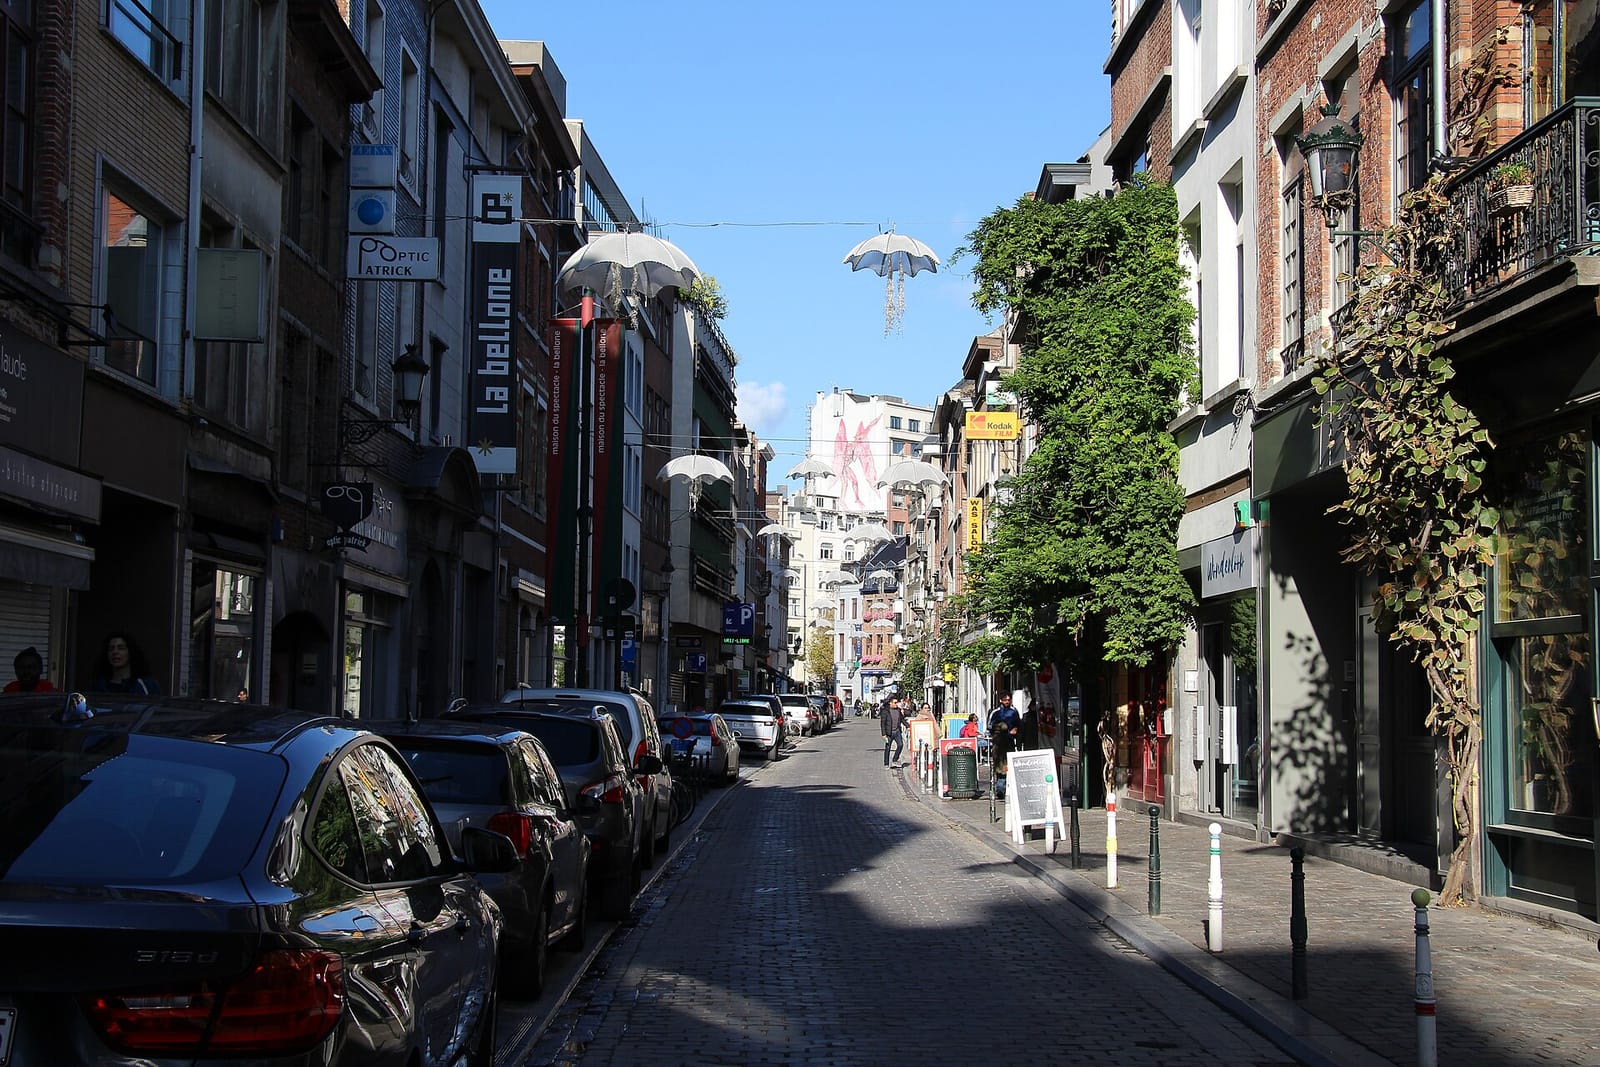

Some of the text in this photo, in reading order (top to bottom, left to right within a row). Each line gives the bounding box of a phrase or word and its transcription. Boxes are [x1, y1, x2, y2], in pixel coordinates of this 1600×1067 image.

[477, 268, 512, 414] la bellone
[553, 330, 561, 360] bellone
[599, 328, 607, 358] bellone
[553, 360, 560, 369] la
[553, 375, 561, 412] spectacle
[598, 373, 606, 411] spectacle
[552, 413, 560, 425] du
[598, 412, 606, 424] du
[987, 422, 1013, 430] Kodak
[598, 425, 606, 454] maison
[970, 500, 979, 551] WAS SALON
[741, 608, 752, 625] P
[698, 655, 706, 667] P
